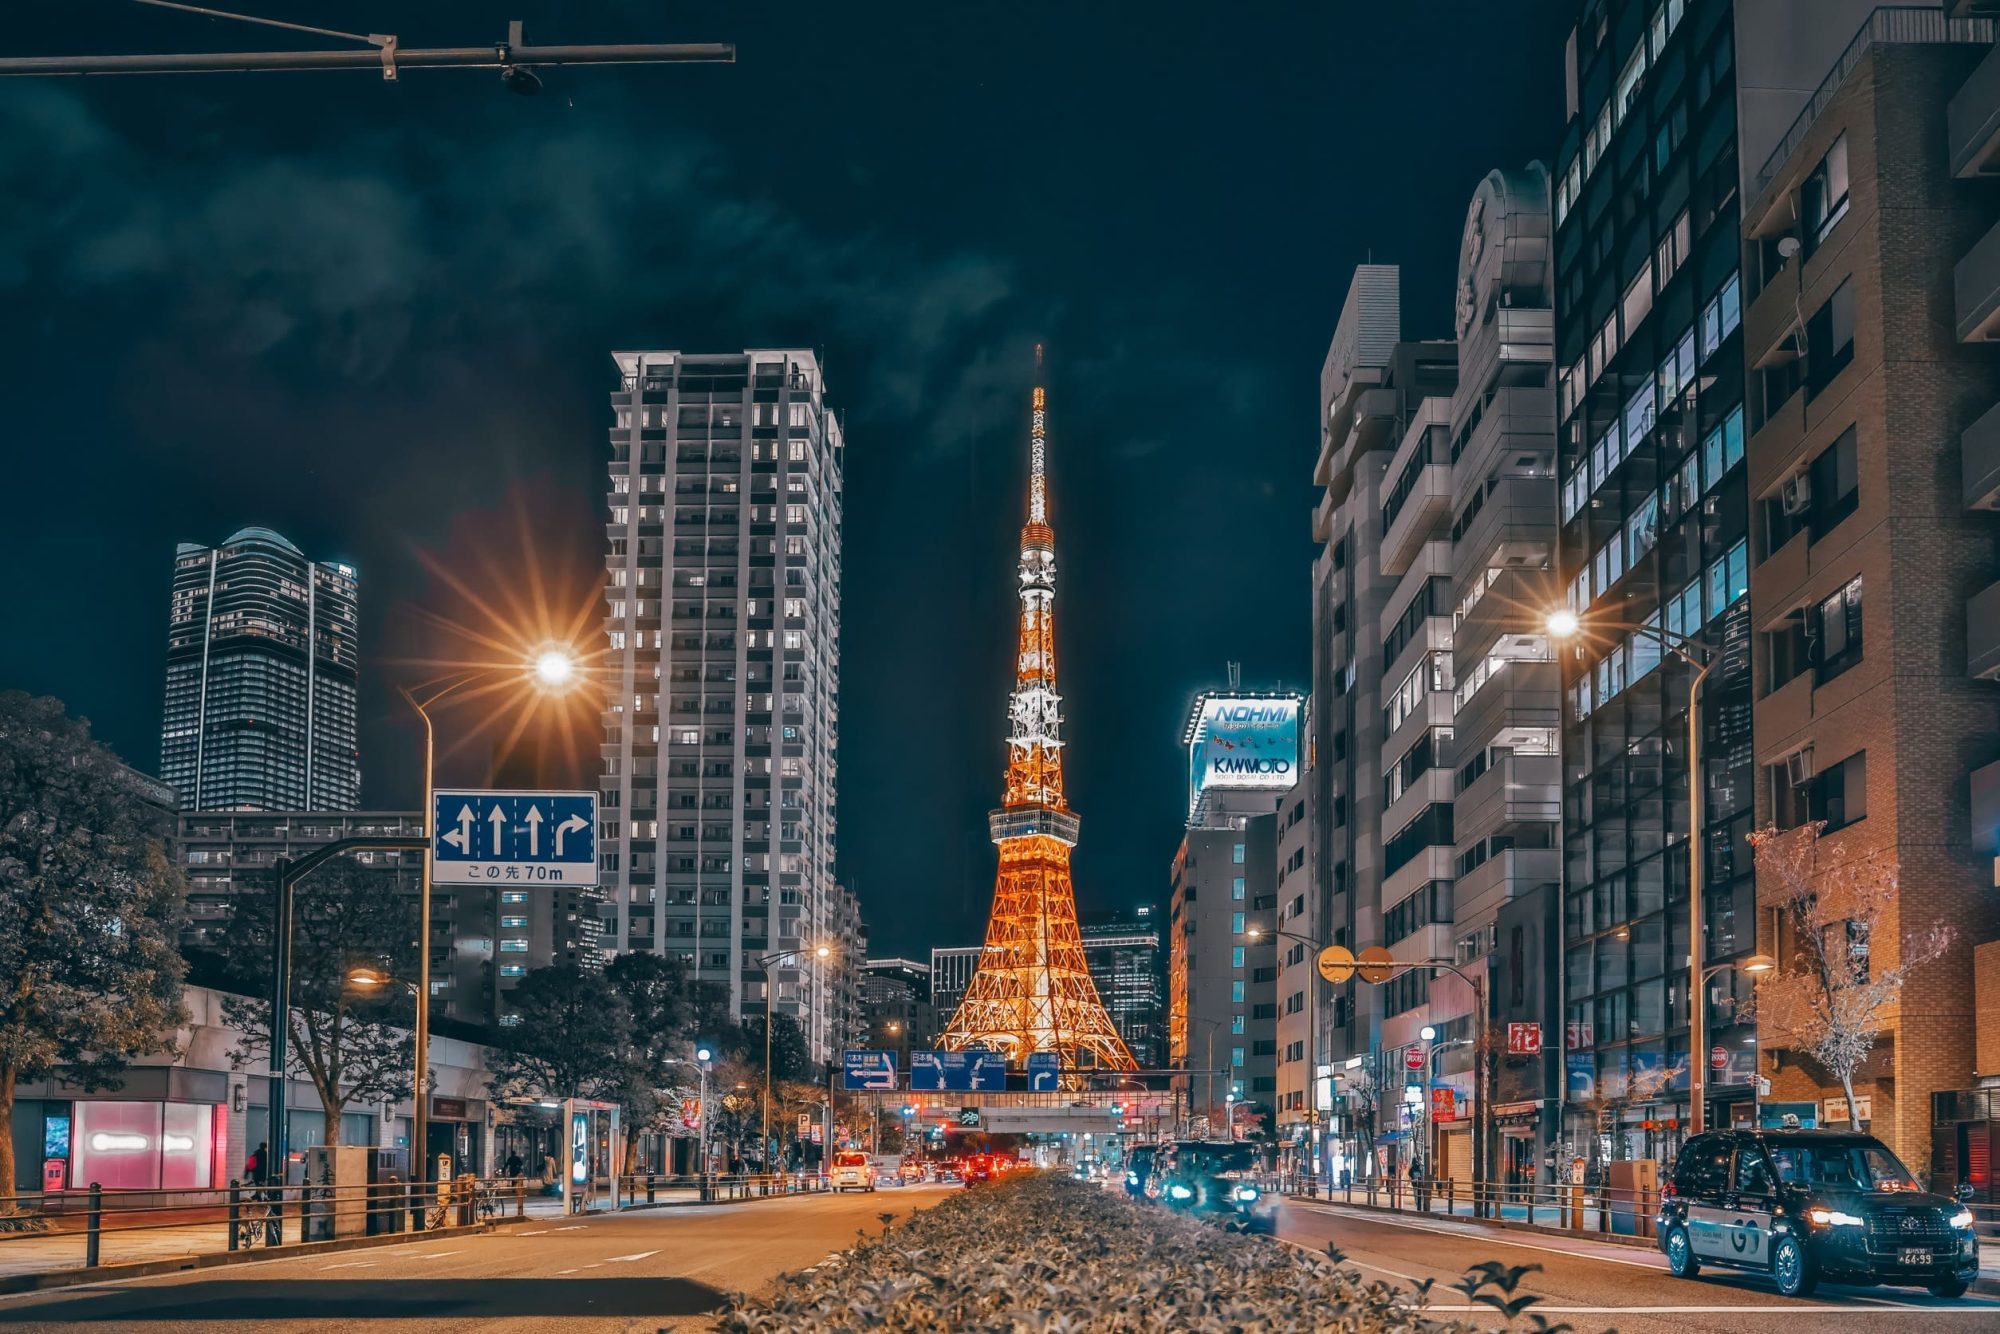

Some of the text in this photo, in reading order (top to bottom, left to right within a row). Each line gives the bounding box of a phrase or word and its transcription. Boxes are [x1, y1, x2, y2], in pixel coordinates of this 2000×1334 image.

[1215, 706, 1289, 721] NOHMI
[468, 866, 563, 880] この先 70m
[1512, 1025, 1538, 1051] 花
[800, 1116, 808, 1125] P
